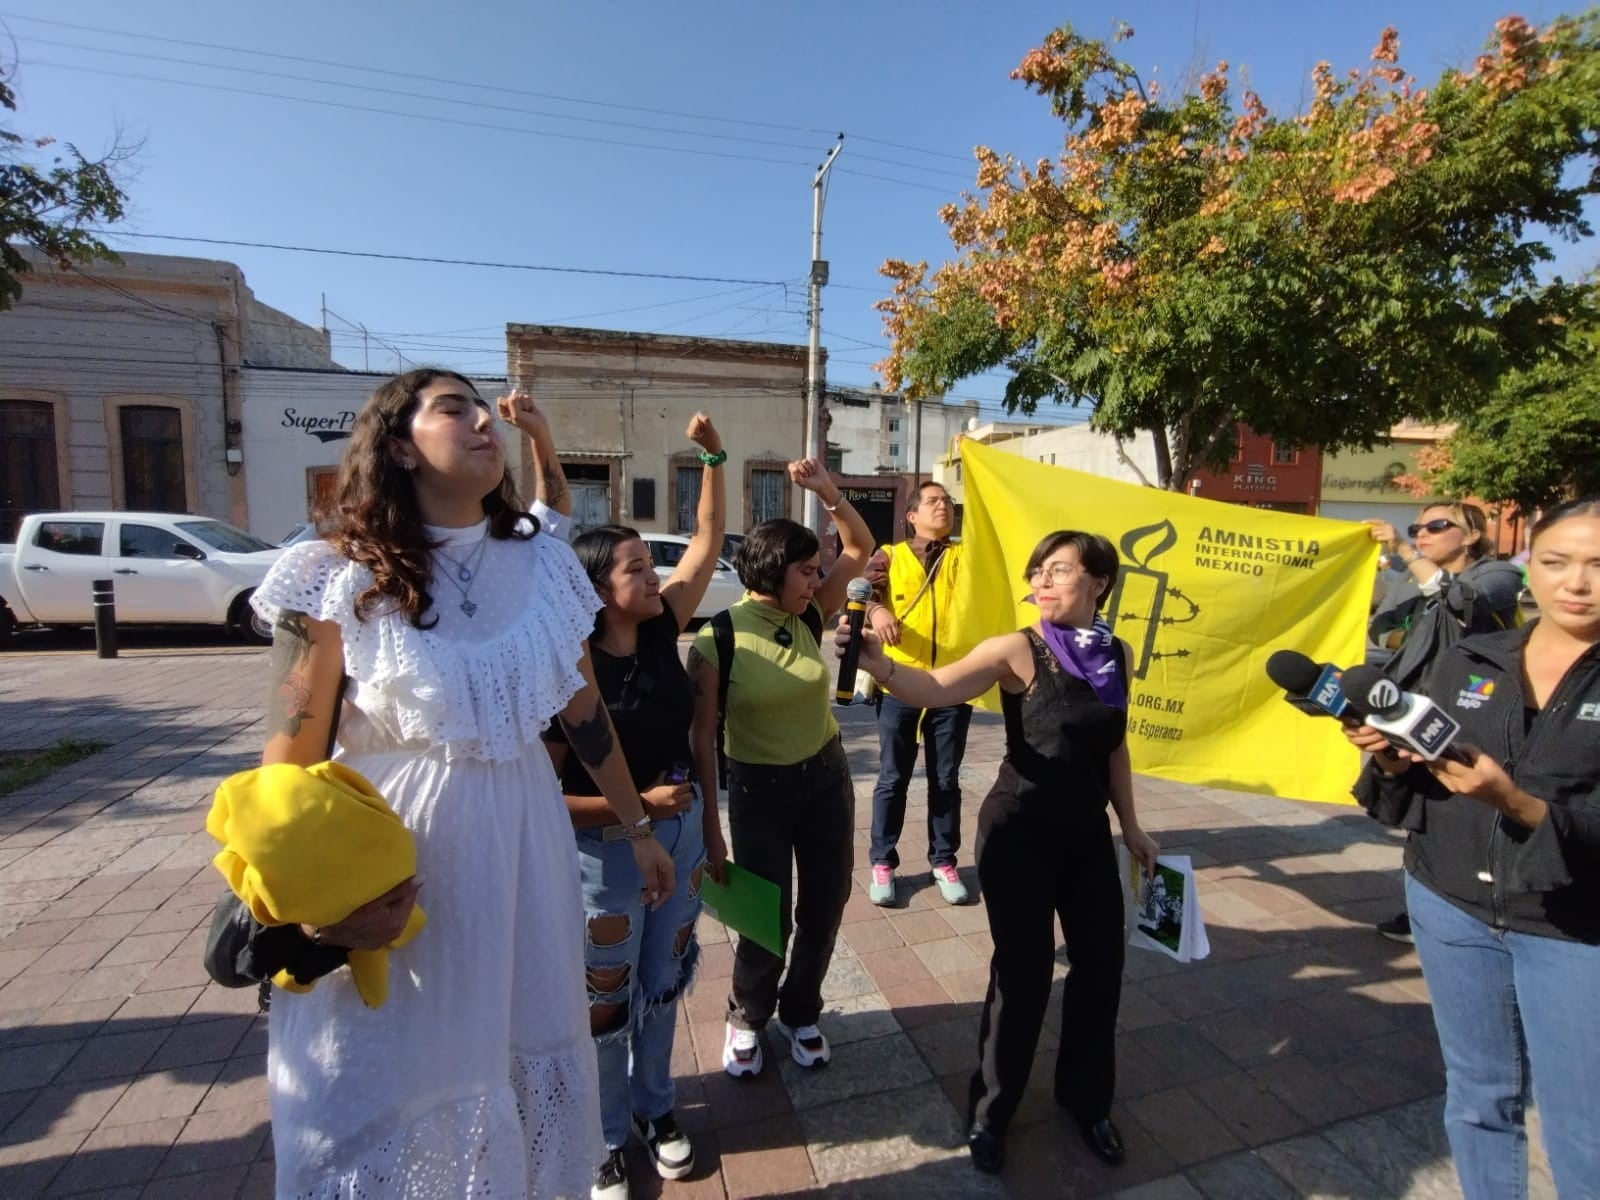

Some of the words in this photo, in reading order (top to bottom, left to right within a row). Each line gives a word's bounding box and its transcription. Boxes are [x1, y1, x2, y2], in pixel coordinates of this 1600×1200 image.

[281, 407, 358, 434] SuperP
[1233, 474, 1276, 484] KING
[1195, 543, 1316, 570] INTERNACIONAL
[1138, 718, 1184, 741] Esperanza
[1421, 717, 1445, 743] MN
